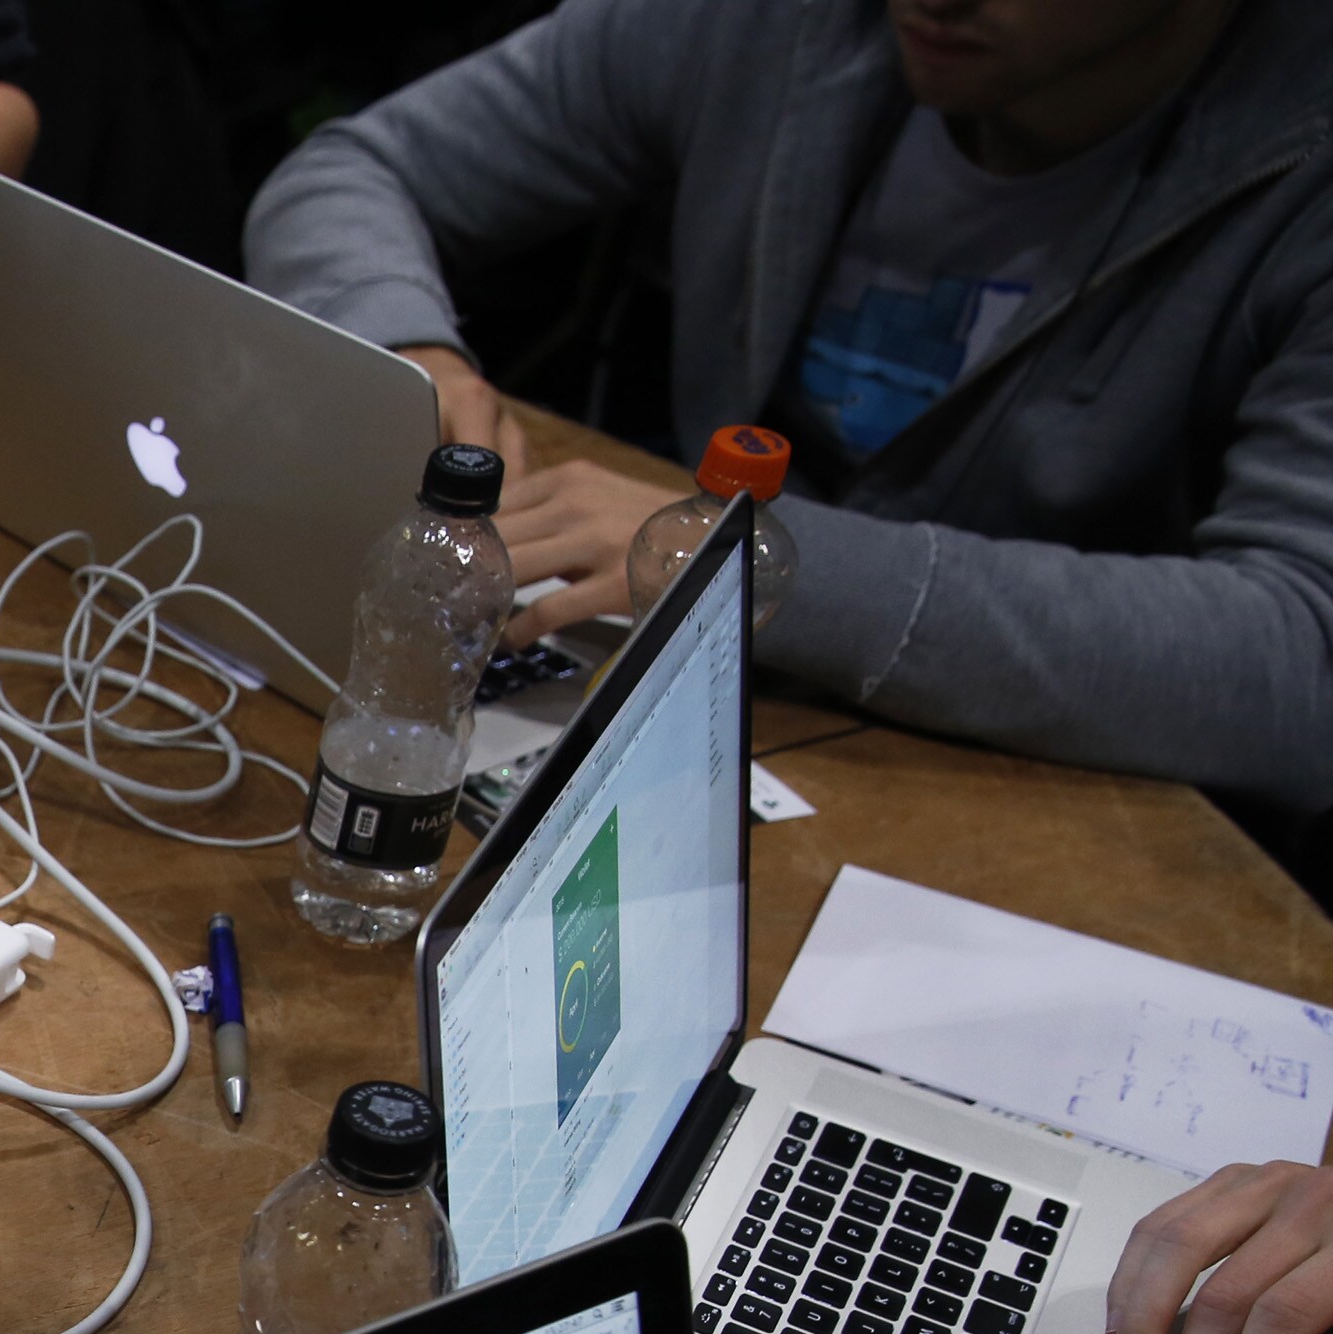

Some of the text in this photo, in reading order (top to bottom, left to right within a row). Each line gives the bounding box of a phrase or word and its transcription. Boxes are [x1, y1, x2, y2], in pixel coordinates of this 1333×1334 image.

[847, 1228, 859, 1237] P
[834, 1256, 847, 1265] O
[875, 1294, 889, 1305] K
[807, 1312, 821, 1321] U
